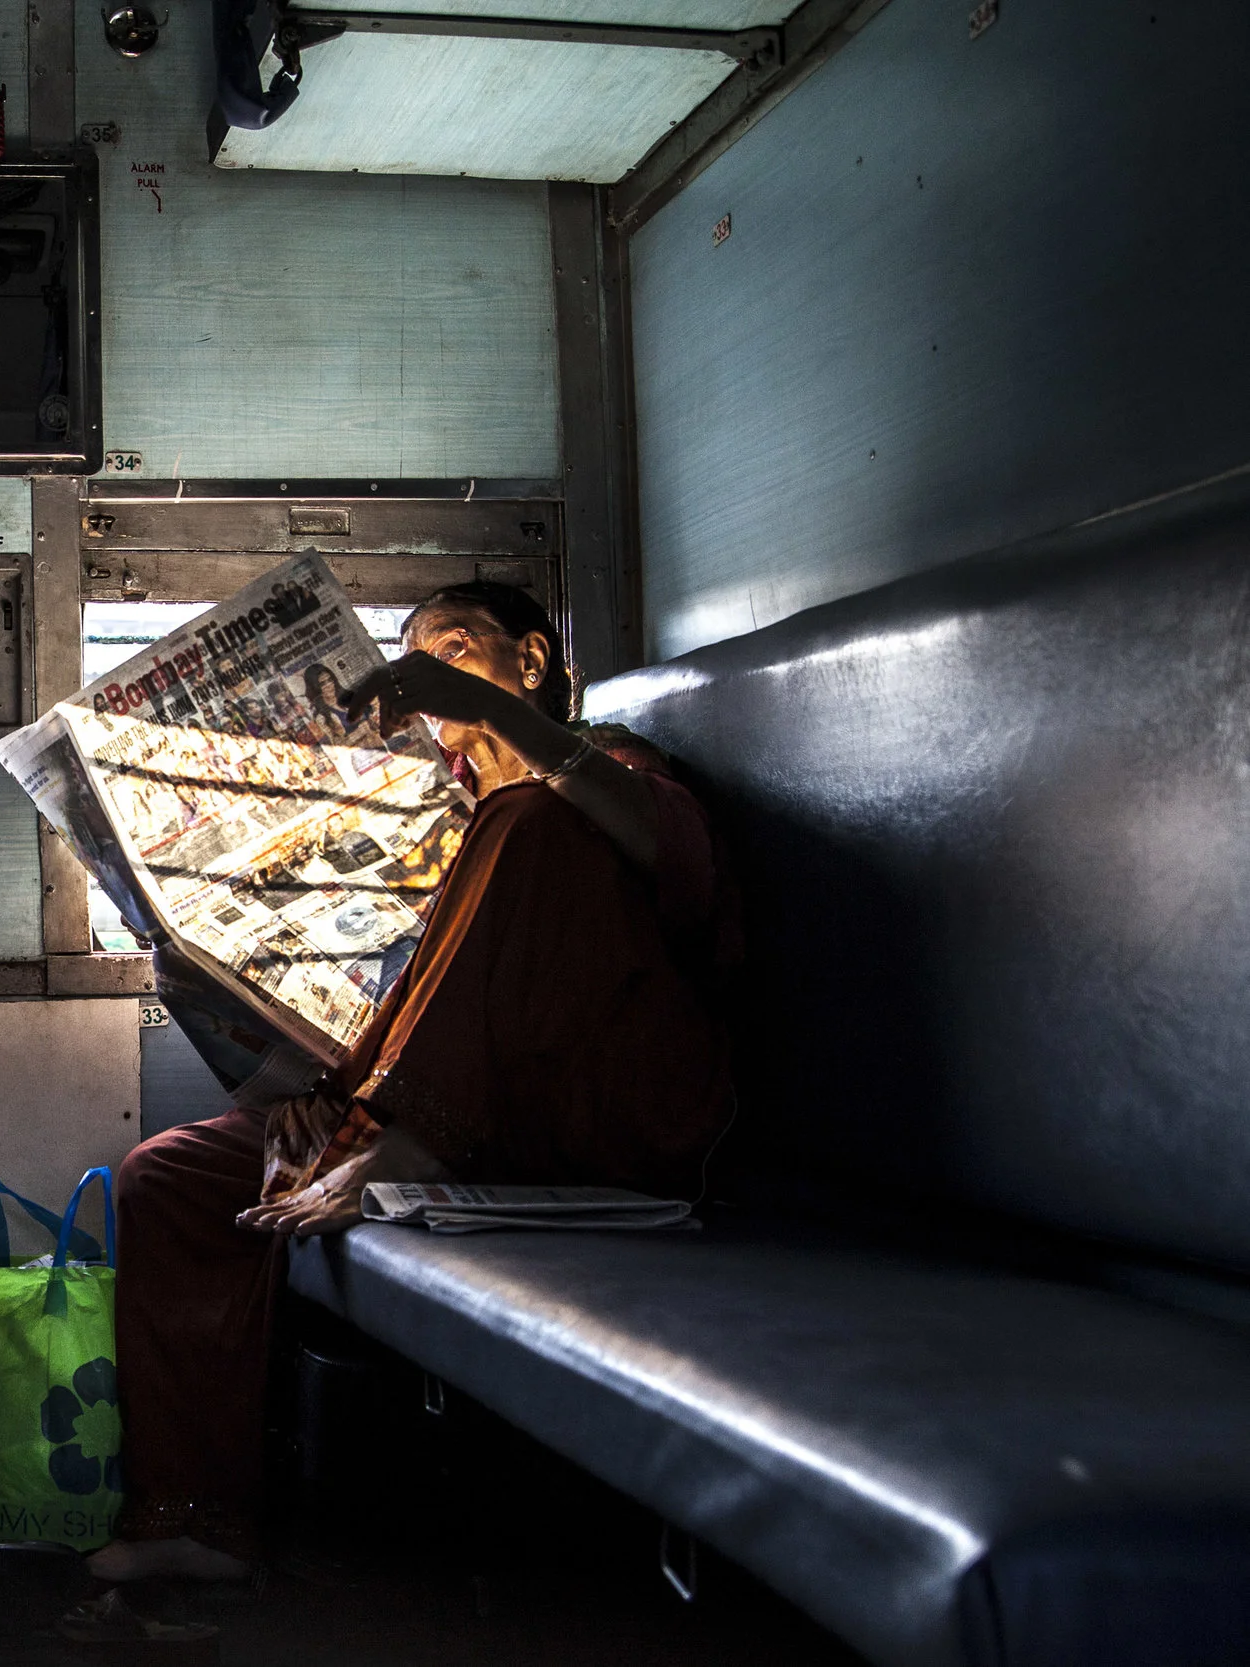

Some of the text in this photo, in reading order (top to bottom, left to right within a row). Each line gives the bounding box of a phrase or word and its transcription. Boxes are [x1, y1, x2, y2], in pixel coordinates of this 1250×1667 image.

[91, 127, 112, 142] 35
[130, 163, 165, 173] ALARM
[137, 178, 160, 188] PULL
[115, 454, 135, 471] 34
[102, 642, 206, 716] Bombay
[193, 596, 284, 661] Times
[92, 730, 134, 766] UNVEILING
[131, 723, 149, 742] THE
[145, 708, 172, 734] MISS
[166, 694, 198, 722] INDIA
[142, 1007, 163, 1025] 33
[0, 1503, 120, 1537] MY SH
